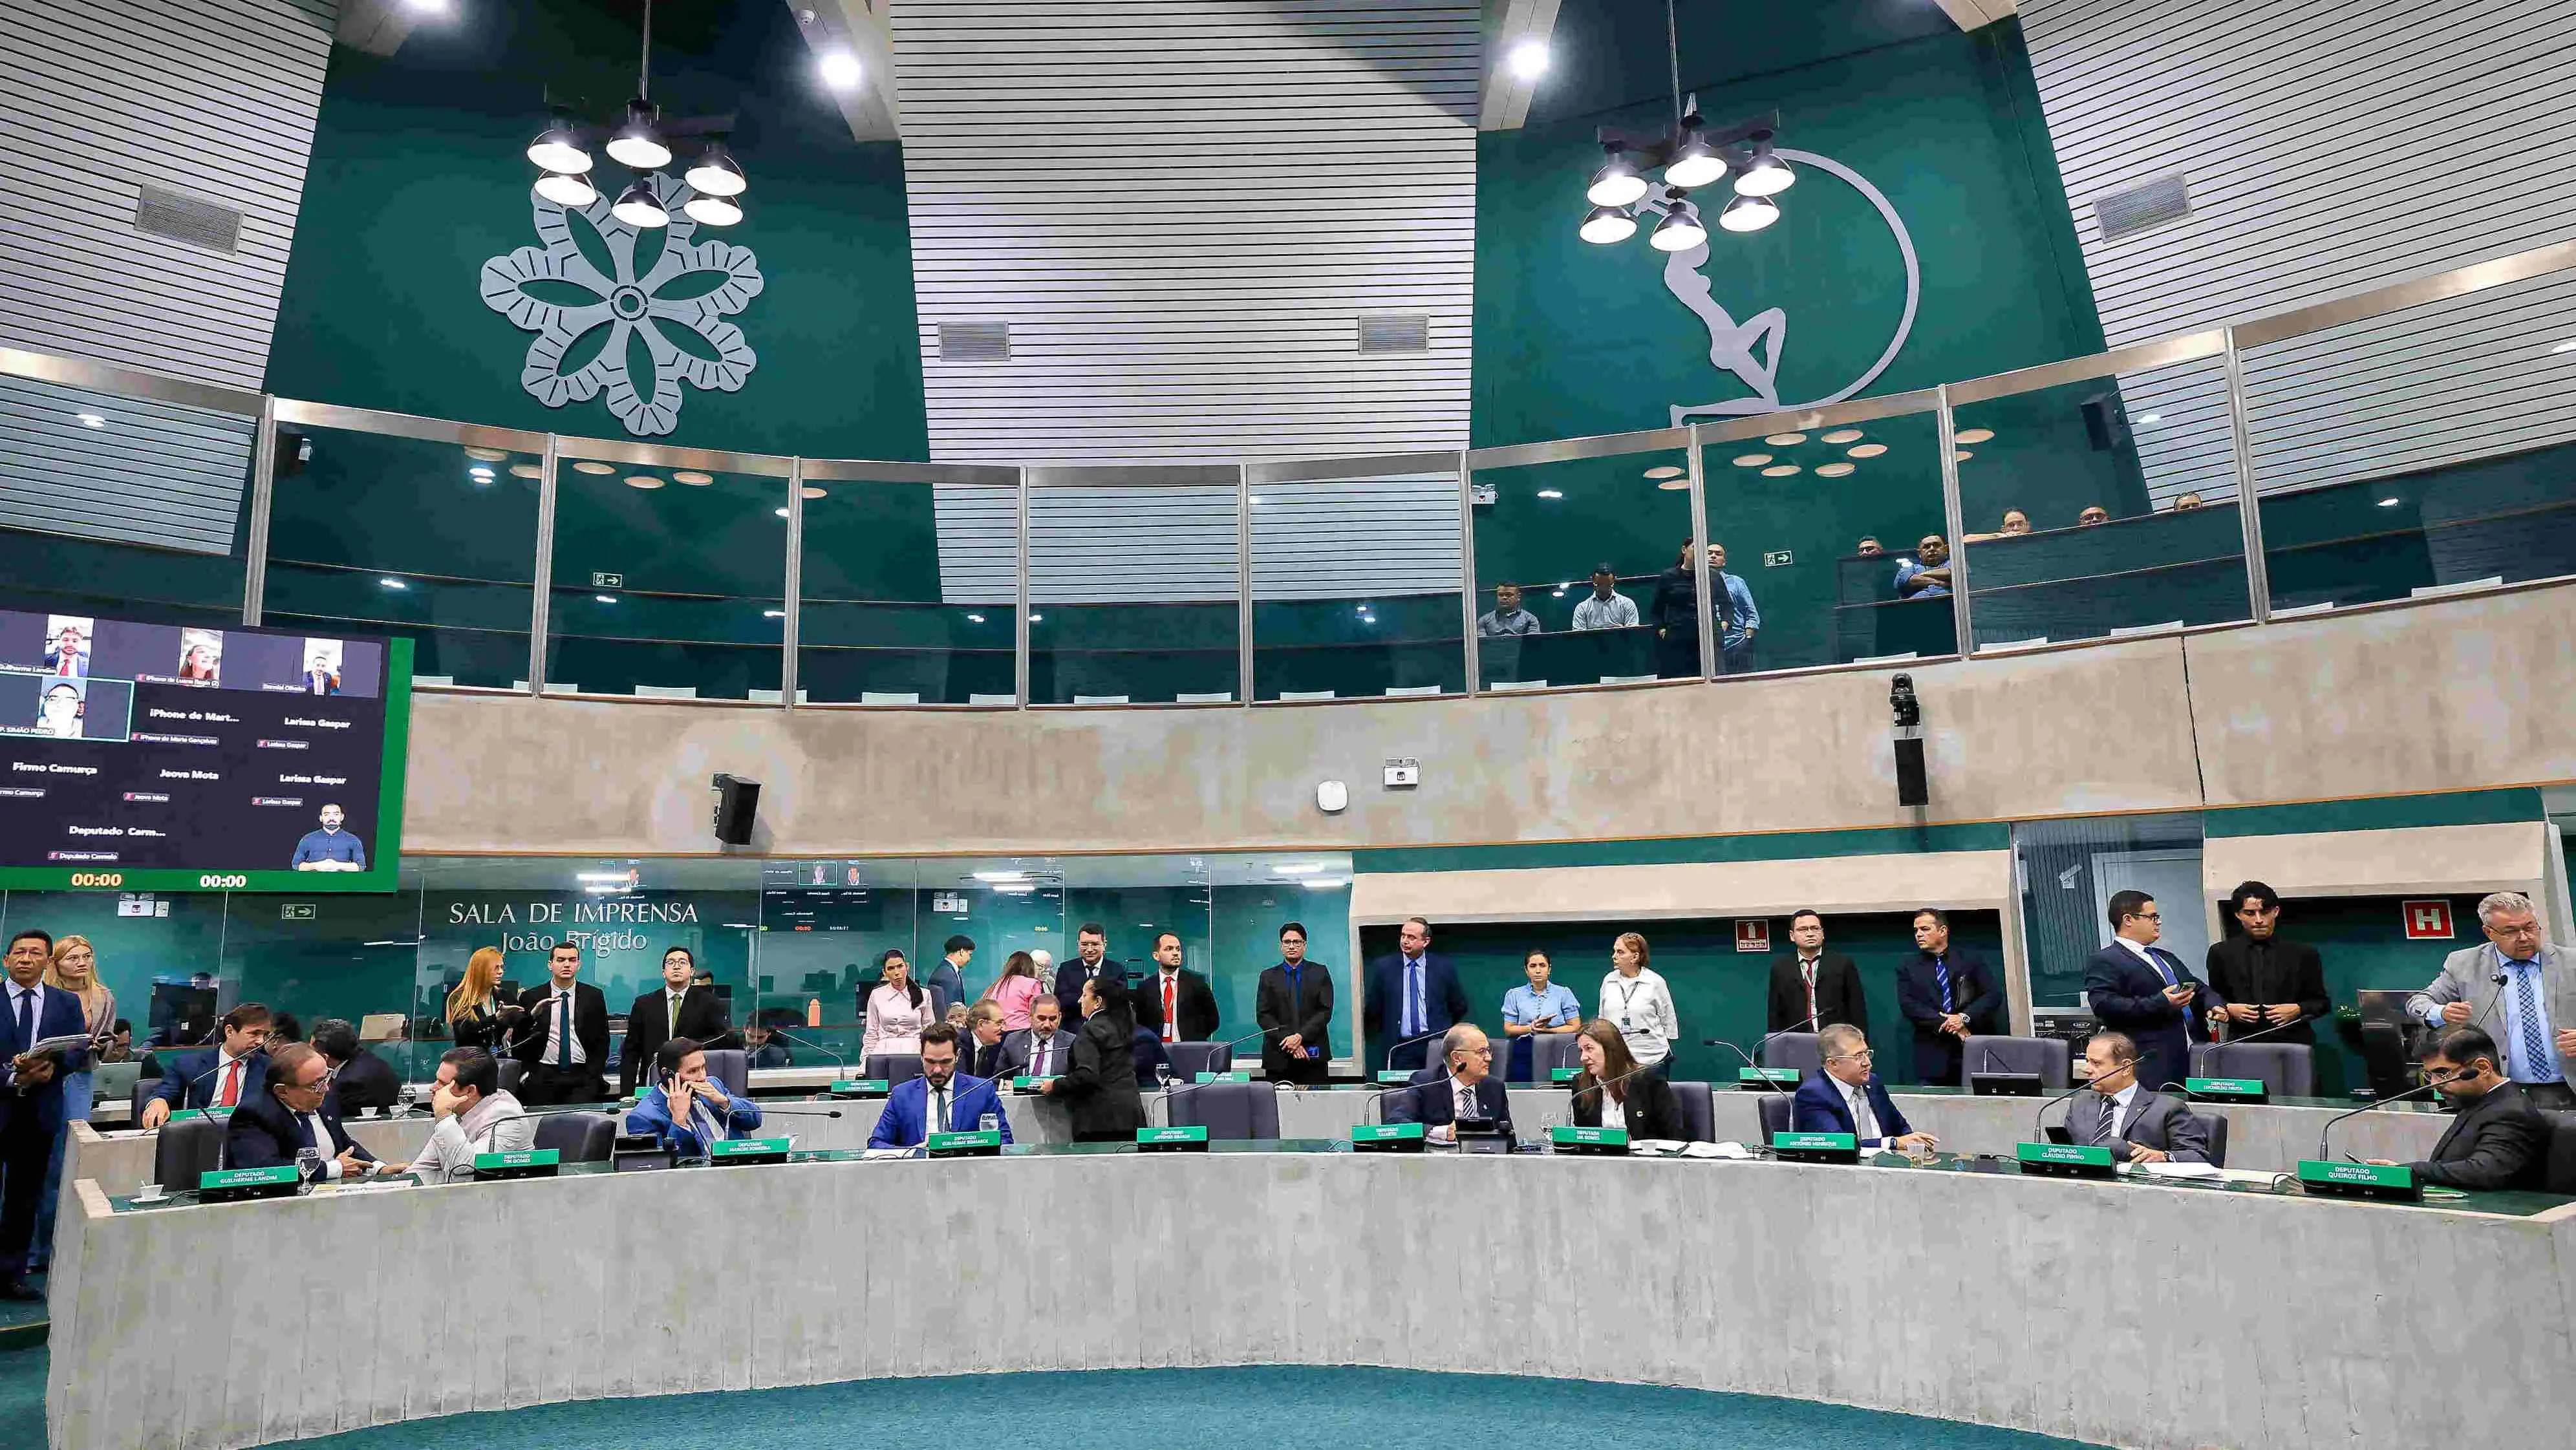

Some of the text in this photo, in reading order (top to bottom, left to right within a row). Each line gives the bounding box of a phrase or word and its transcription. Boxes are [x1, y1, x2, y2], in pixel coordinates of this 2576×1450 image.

[150, 709, 186, 719] iPhone
[189, 711, 202, 720] de
[284, 717, 351, 729] Larissa Gaspar
[12, 762, 97, 775] Firmo Camurça
[192, 771, 219, 780] Mota
[279, 774, 347, 785] Larissa Gaspar
[69, 826, 123, 836] Deputado
[72, 873, 122, 886] 00:00
[200, 875, 247, 888] 00:00
[449, 902, 698, 924] SALA DE IMPRENSA
[2415, 909, 2442, 930] H
[502, 929, 647, 957] João Brígido
[2328, 1171, 2357, 1180] QUEIROZ
[2335, 1166, 2370, 1175] DEPUTADO
